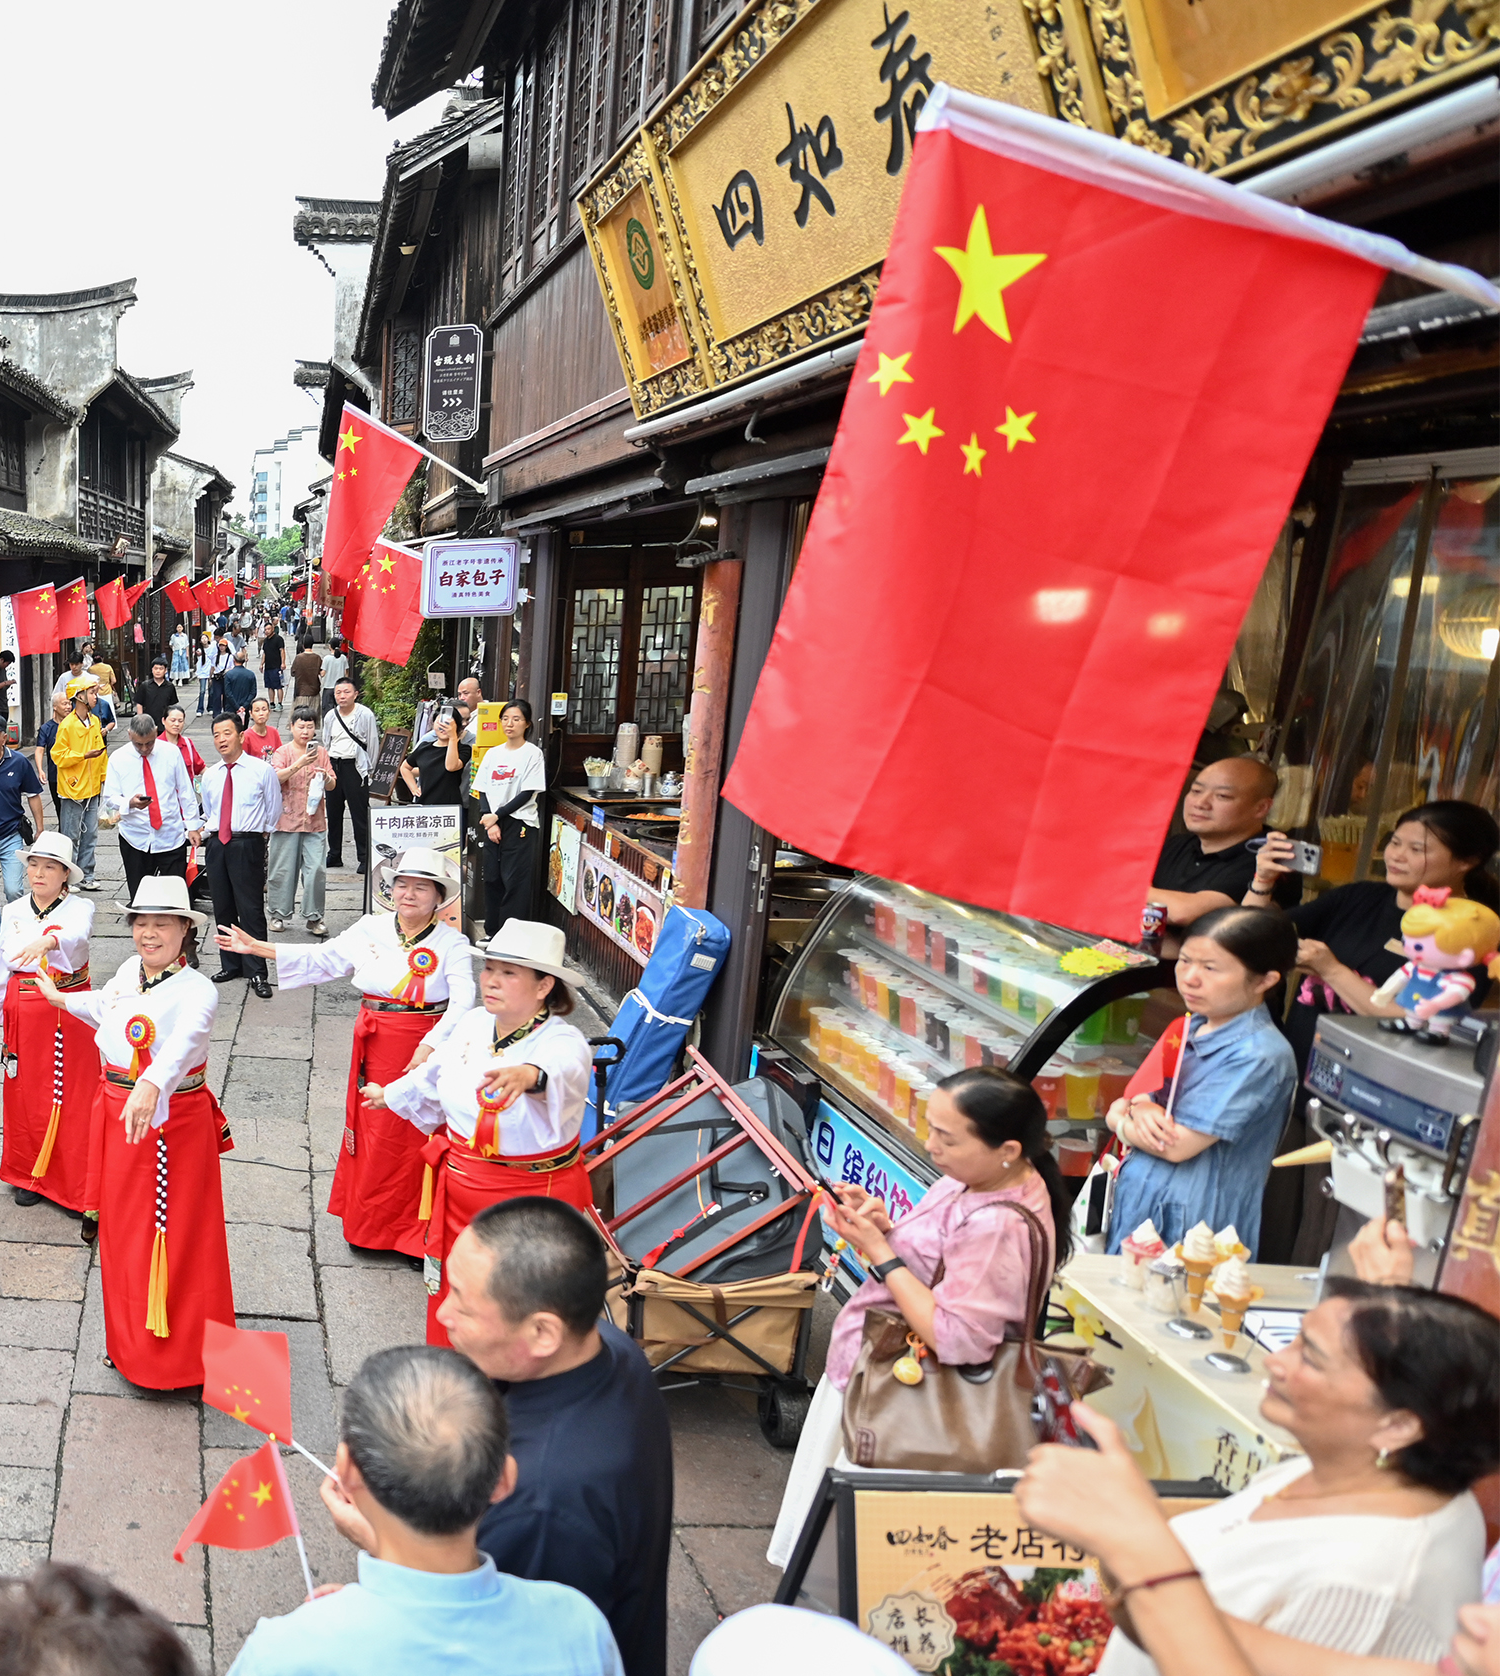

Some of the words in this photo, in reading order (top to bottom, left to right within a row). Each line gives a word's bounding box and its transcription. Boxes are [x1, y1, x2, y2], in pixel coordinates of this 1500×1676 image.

[433, 353, 475, 367] 古玩文创
[442, 557, 504, 566] 浙江老字号非遗传承
[439, 568, 505, 588] 白家包子
[375, 815, 456, 830] 牛肉麻酱凉面
[886, 1525, 959, 1551] 四如春
[886, 1606, 935, 1631] 店长
[889, 1632, 937, 1657] 推荐
